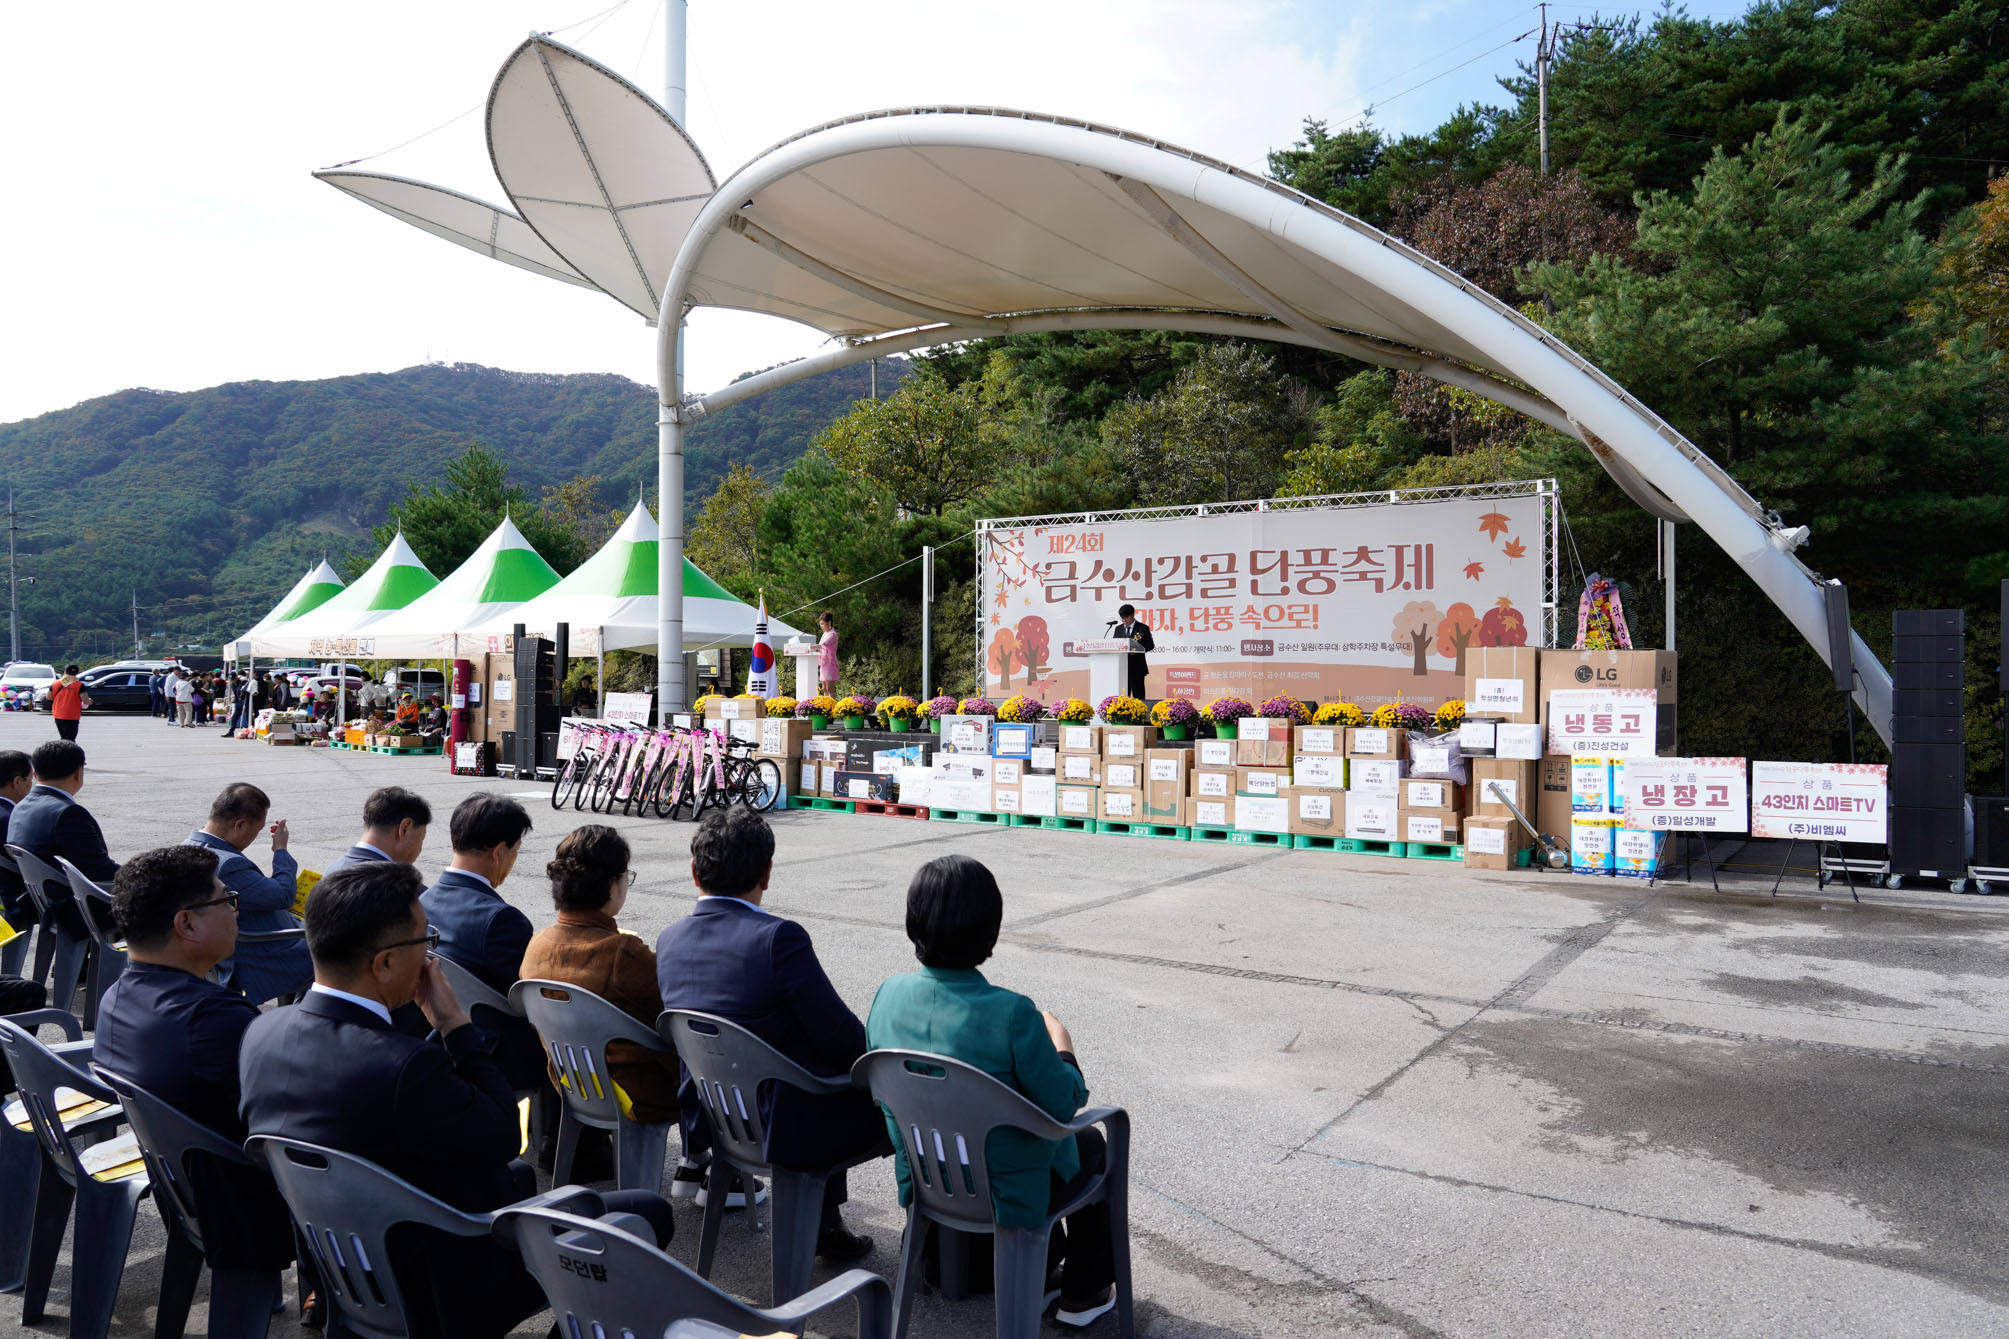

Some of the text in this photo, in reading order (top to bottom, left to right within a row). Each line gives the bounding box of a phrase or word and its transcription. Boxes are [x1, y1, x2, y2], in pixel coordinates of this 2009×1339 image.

[1048, 533, 1104, 554] 제24회
[1043, 543, 1434, 604] 금수산감골 단풍축제
[1189, 606, 1235, 633] 단풍
[1239, 603, 1319, 631] 속으로!
[1149, 646, 1166, 654] 8:00
[1278, 642, 1413, 652] 금수산 일원(주무대: 상학주차장 특설무대)
[1596, 668, 1617, 681] LG
[1564, 713, 1641, 734] 냉동고
[1641, 784, 1730, 807] 냉장고
[1761, 794, 1877, 813] 43인치 스마트TV
[1652, 814, 1717, 827] (증)일성개발
[1788, 823, 1847, 837] (주)비엠씨
